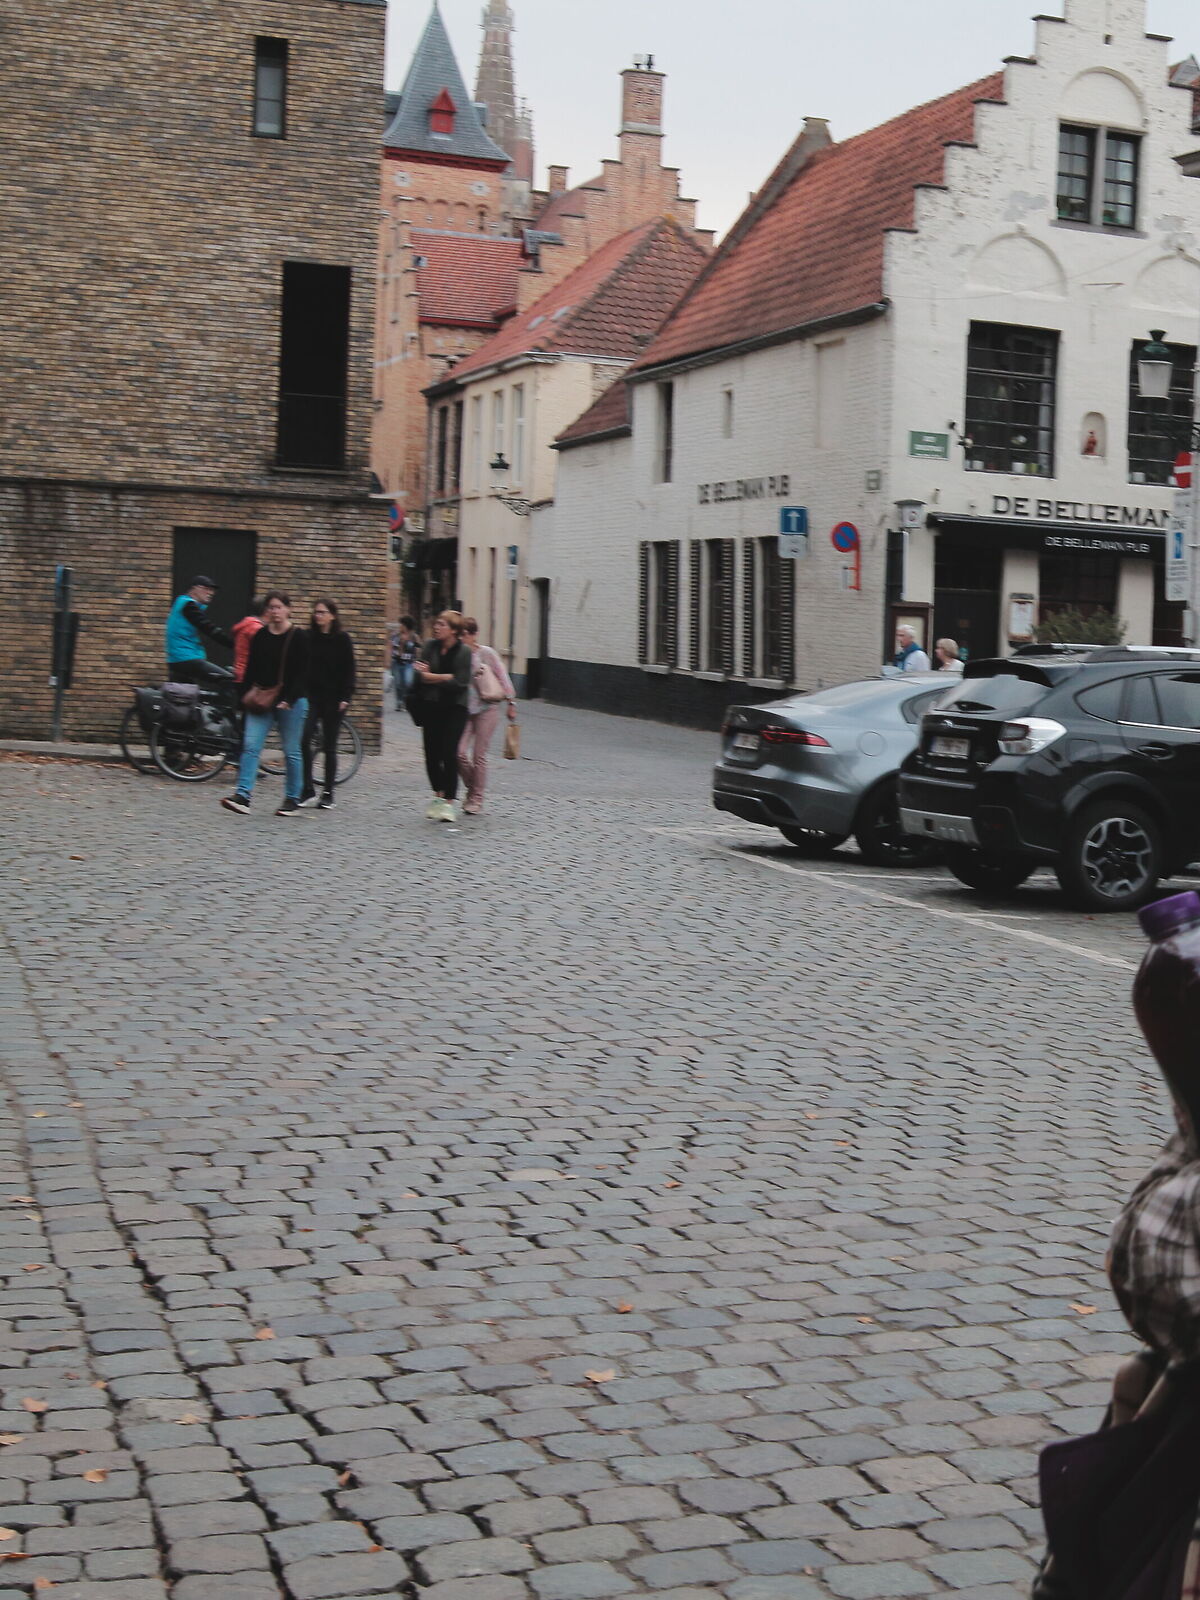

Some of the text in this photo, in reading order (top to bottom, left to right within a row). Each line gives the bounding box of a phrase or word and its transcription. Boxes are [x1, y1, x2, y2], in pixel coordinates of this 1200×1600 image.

[993, 495, 1029, 516] DE
[1045, 536, 1150, 553] DE BELLEMAN PUB
